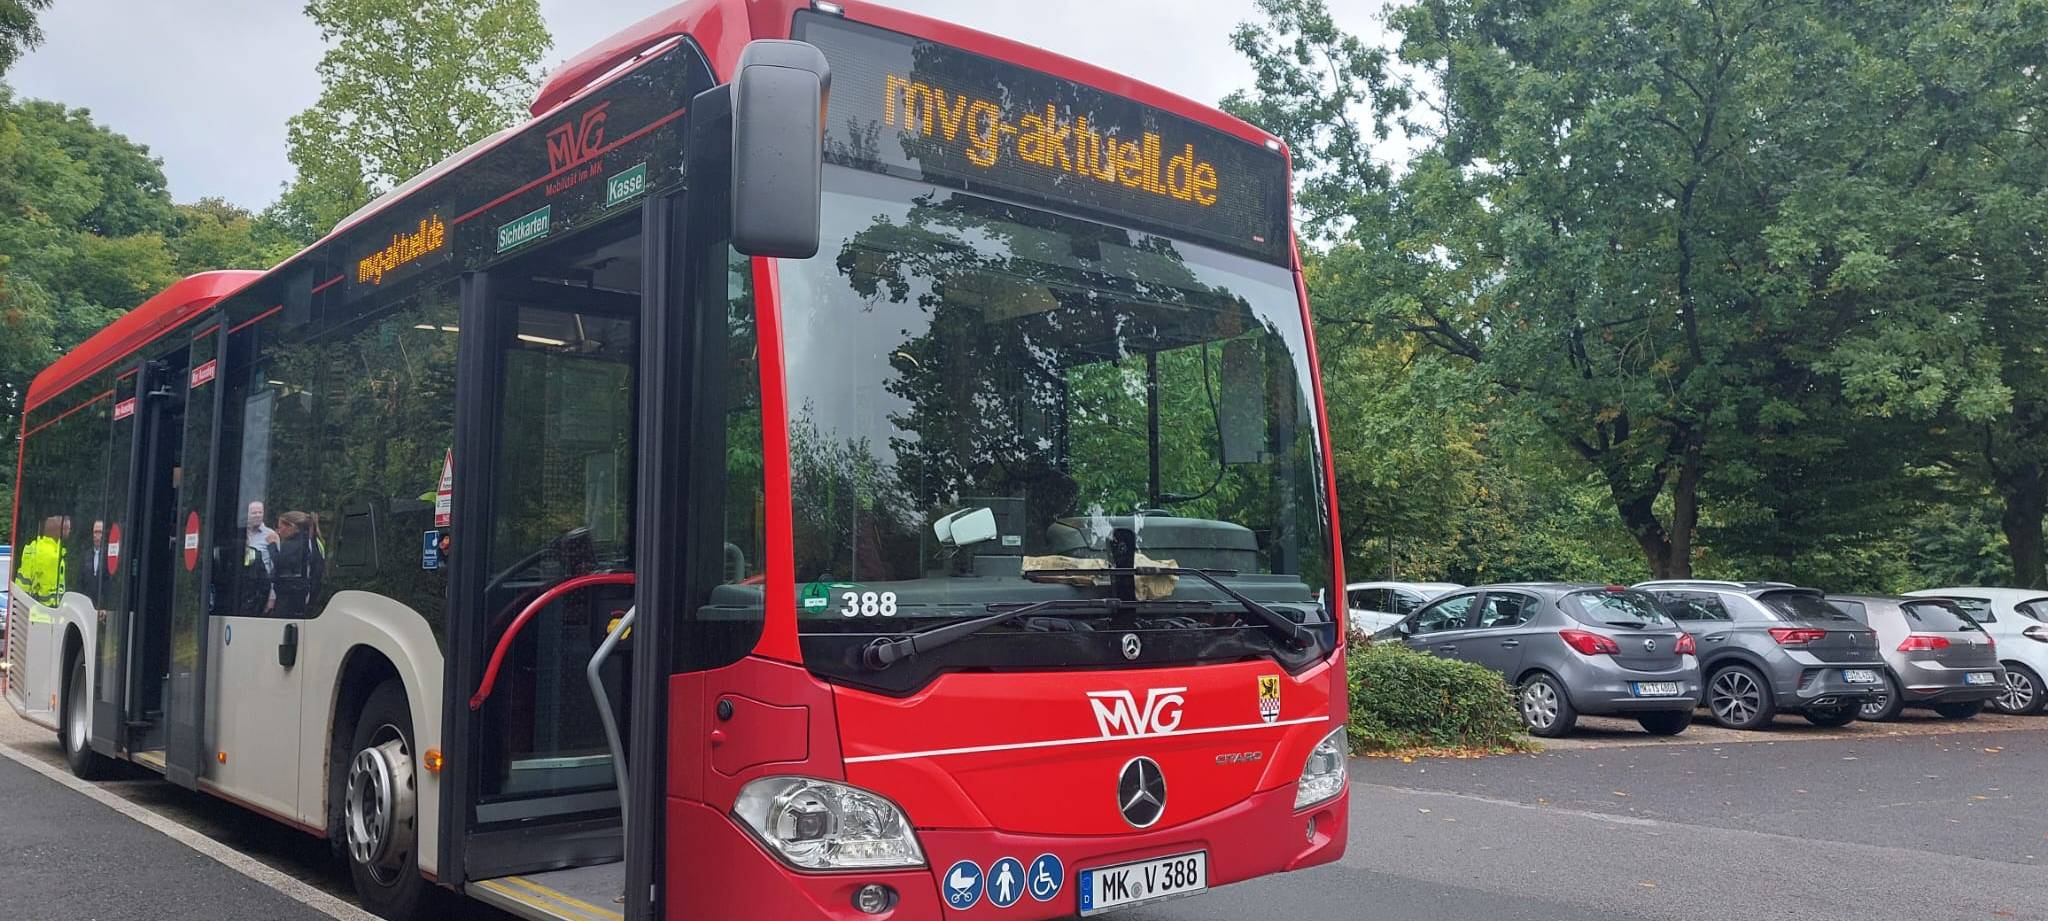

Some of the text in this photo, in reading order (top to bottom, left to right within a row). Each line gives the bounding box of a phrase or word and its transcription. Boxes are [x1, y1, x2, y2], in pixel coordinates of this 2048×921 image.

[546, 101, 610, 176] MVG
[884, 73, 1218, 206] mvg-aktuell.de
[545, 173, 577, 196] Mobilität
[609, 174, 642, 202] Kasse
[358, 213, 445, 285] mvg-aktuell.de
[499, 215, 549, 247] Sichtkarten
[841, 591, 897, 617] 388
[1086, 687, 1187, 739] MVG
[1102, 858, 1198, 902] MK V 388
